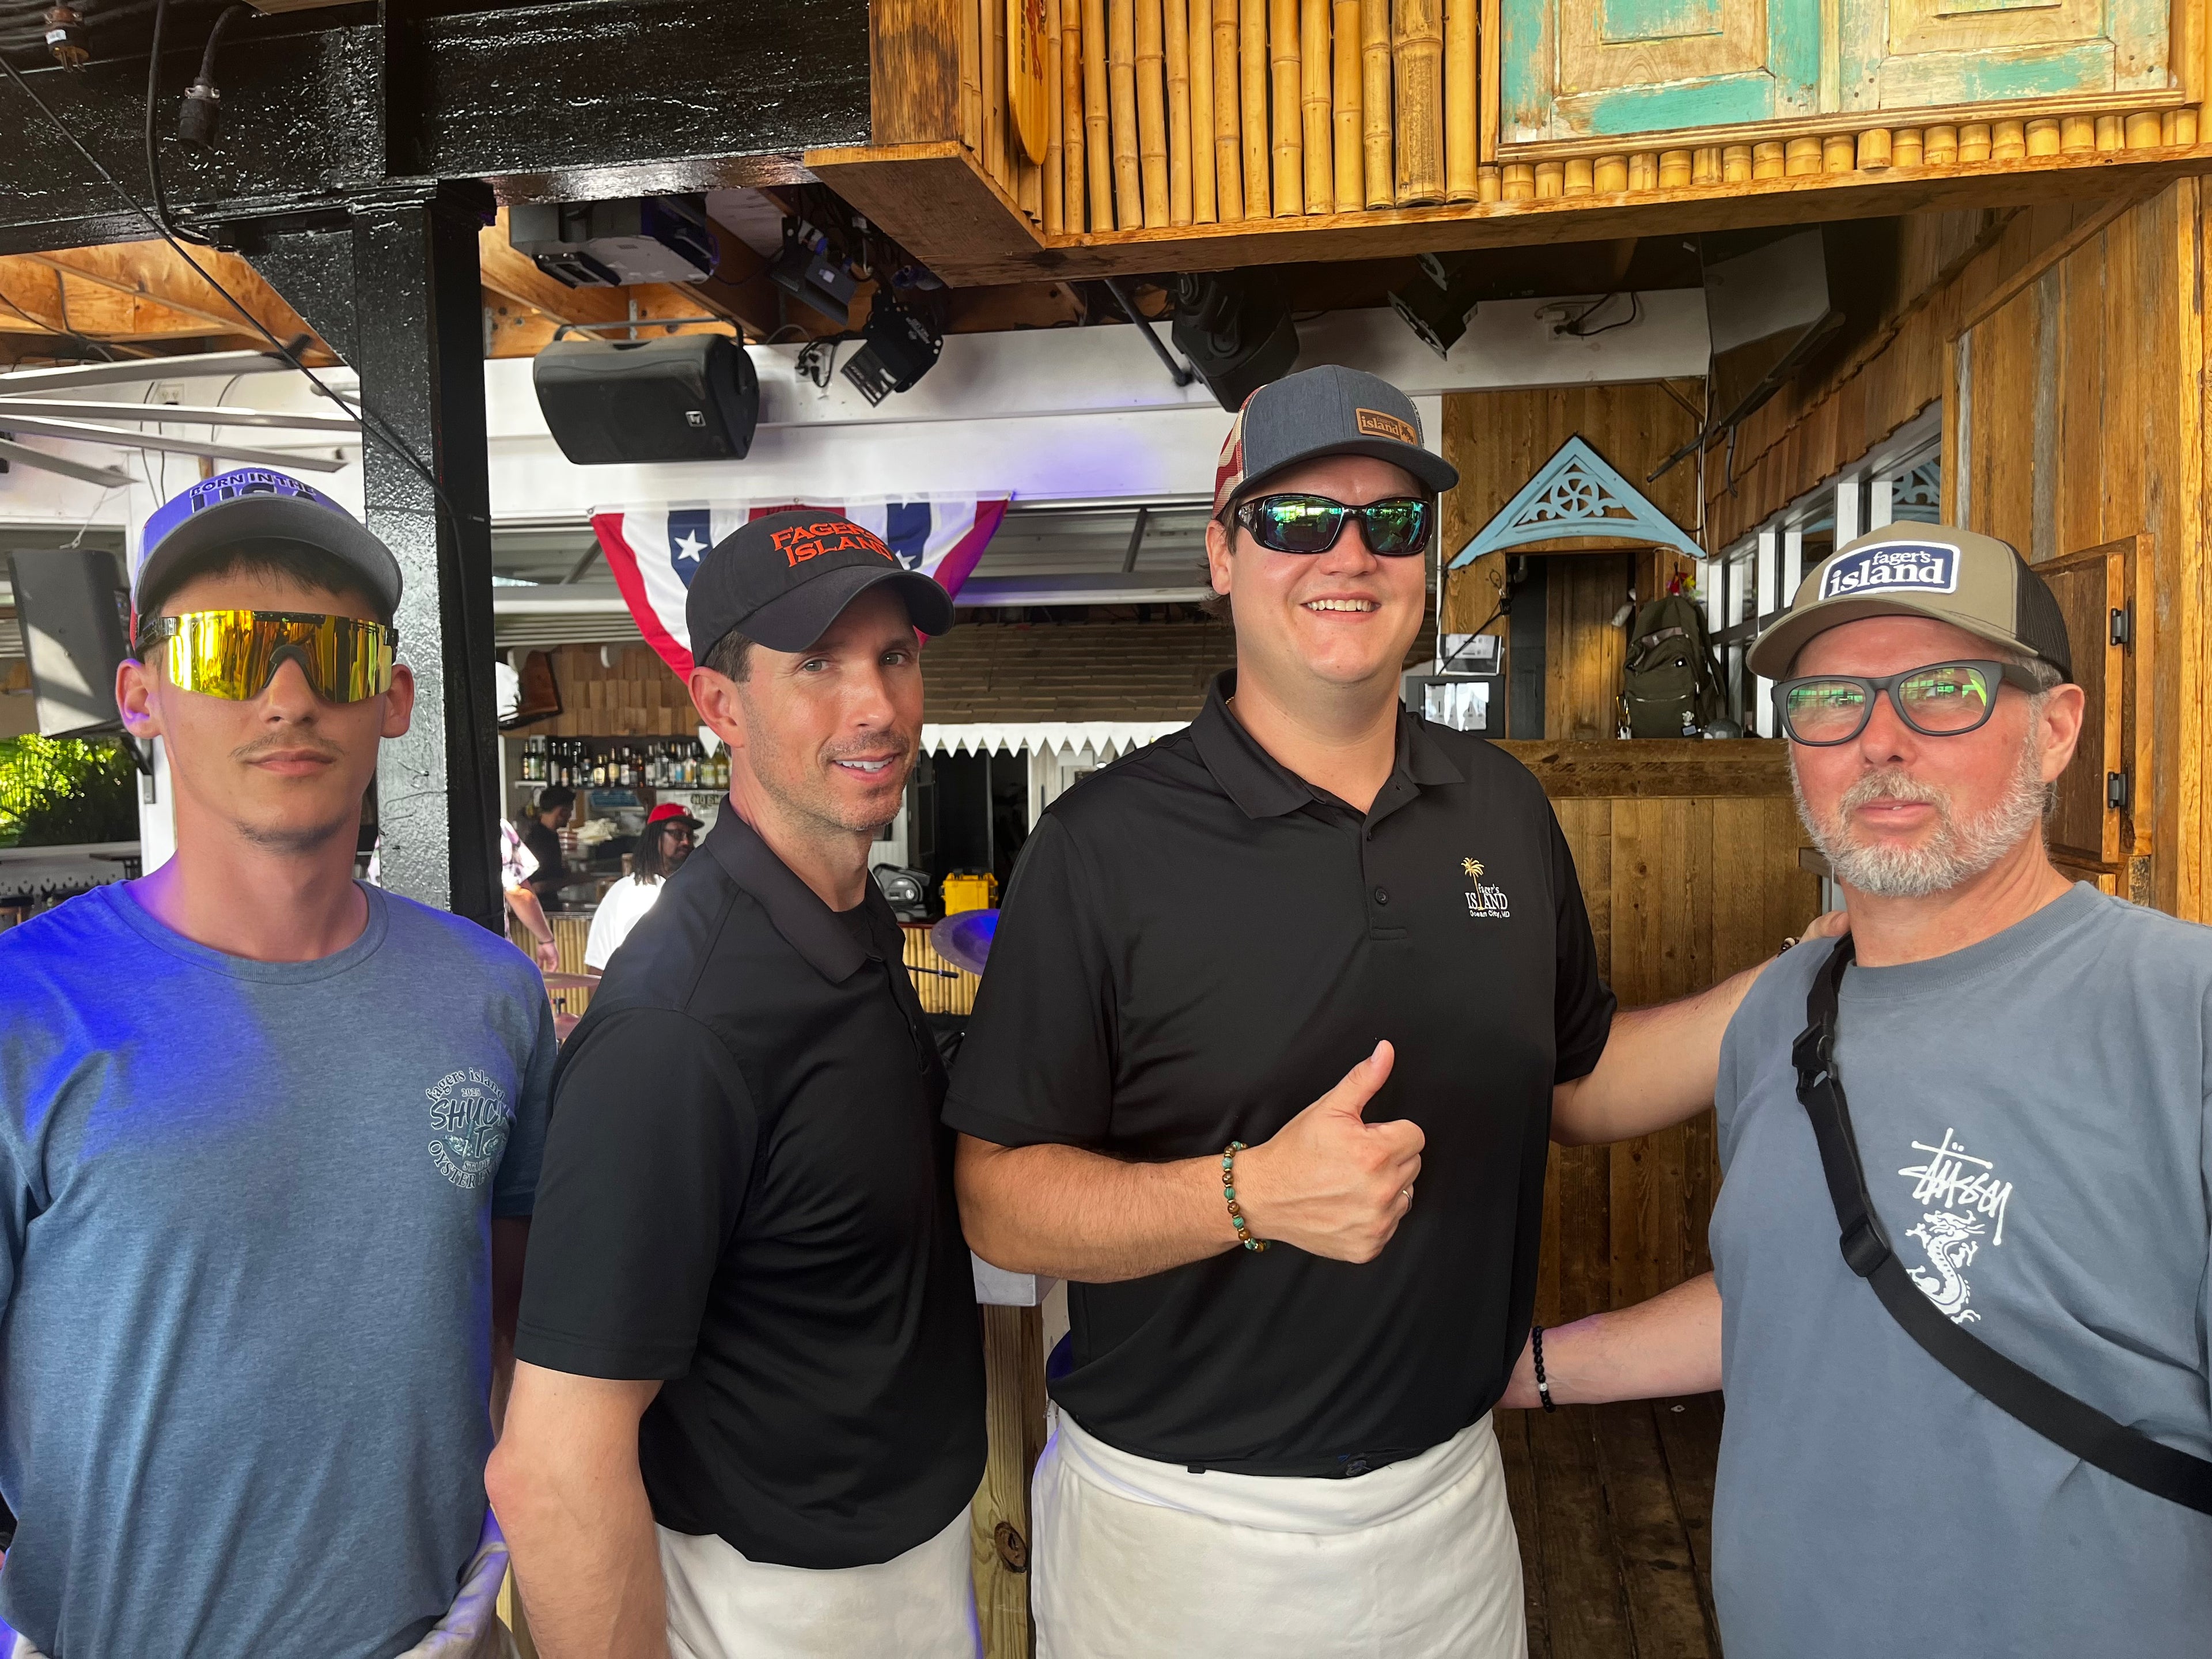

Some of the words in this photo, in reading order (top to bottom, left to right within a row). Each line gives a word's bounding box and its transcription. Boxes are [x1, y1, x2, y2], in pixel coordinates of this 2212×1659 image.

[1361, 416, 1400, 435] island
[190, 473, 246, 498] BORN
[248, 472, 275, 484] IN
[275, 474, 317, 496] THE
[783, 536, 893, 567] ISLAND
[1872, 551, 1932, 566] fager's
[1828, 558, 1945, 597] island
[426, 1070, 466, 1101] fagers
[469, 1067, 505, 1100] island
[430, 1096, 510, 1132] SHUCK
[429, 1139, 476, 1189] OYSTER
